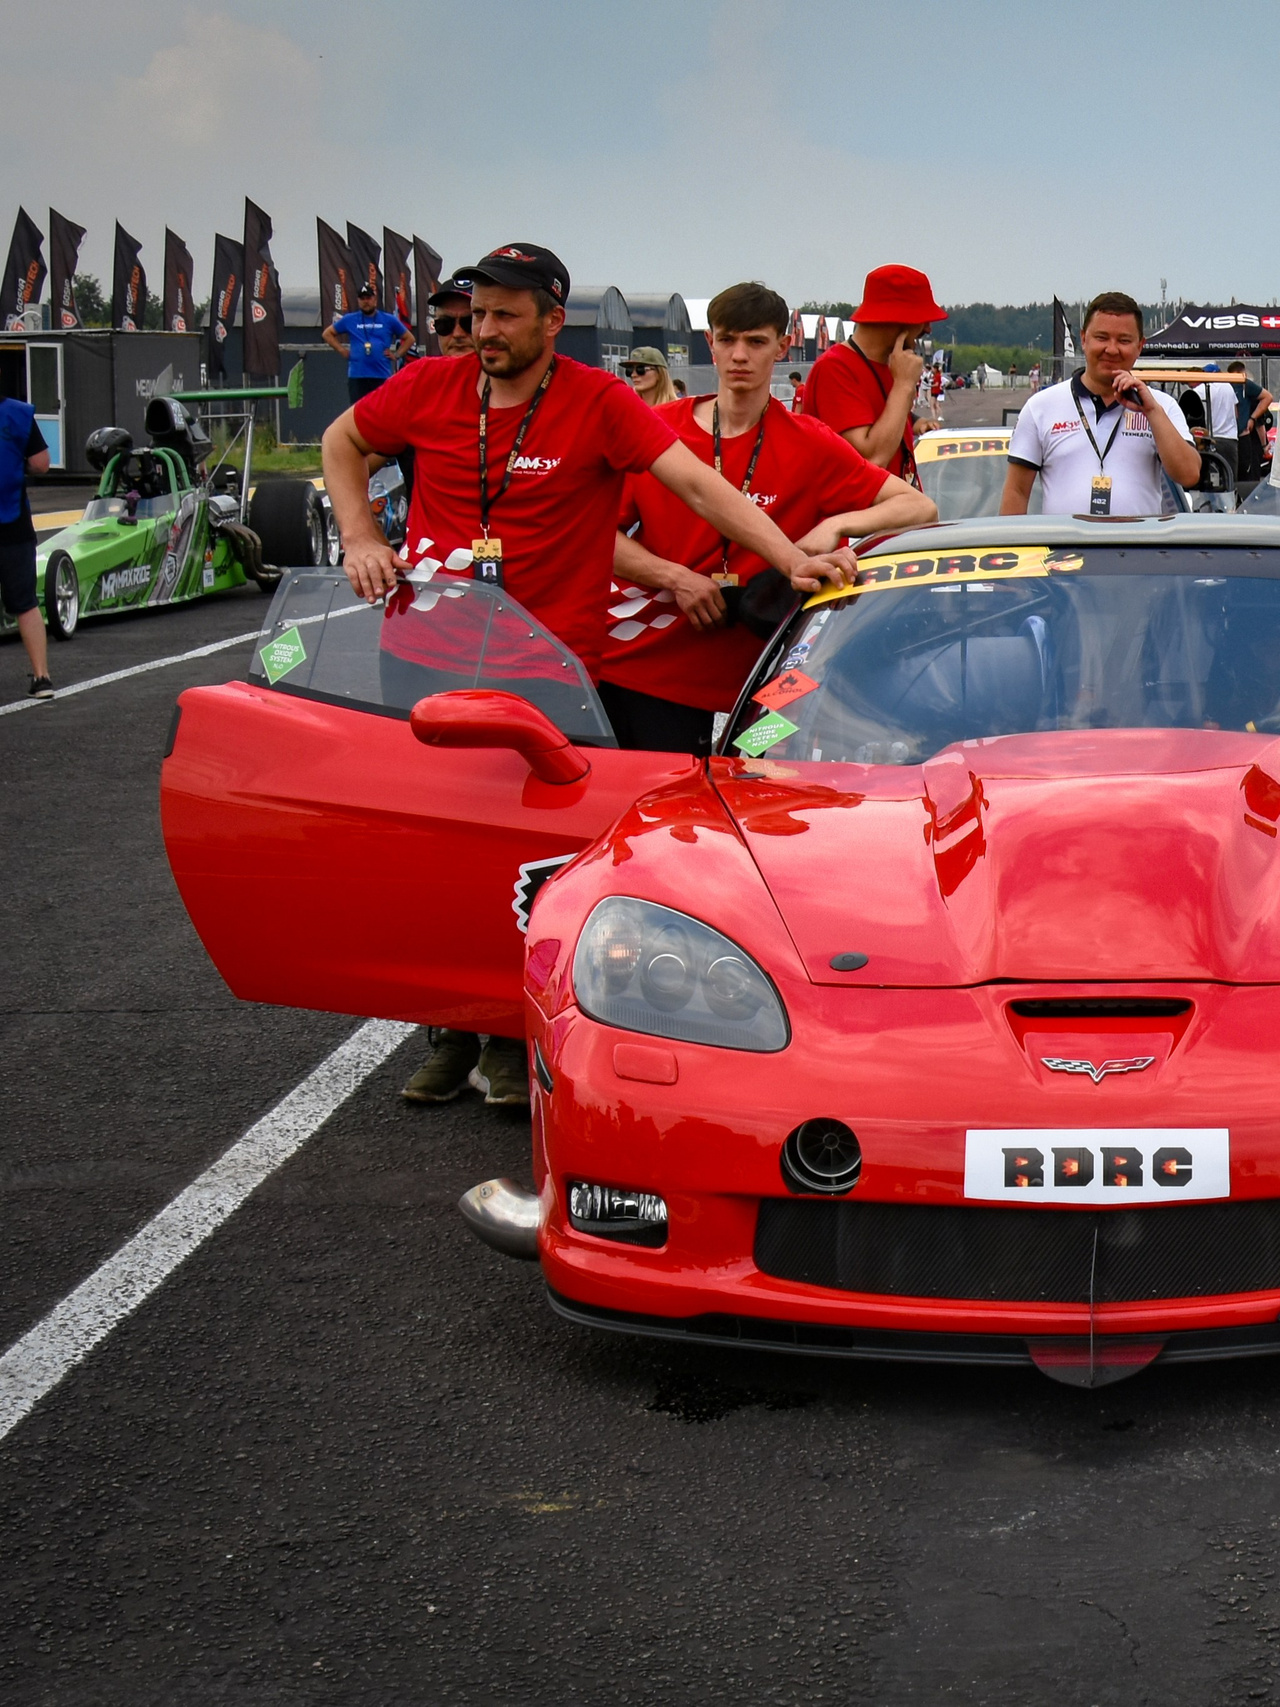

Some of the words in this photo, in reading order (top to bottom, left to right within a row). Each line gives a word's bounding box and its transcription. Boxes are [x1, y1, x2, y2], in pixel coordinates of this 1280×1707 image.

[1209, 342, 1260, 350] ПРОИЗВОДСТВО
[937, 440, 1011, 456] RDR
[852, 552, 1019, 588] RDRC
[761, 688, 803, 699] ALCOHOL
[749, 723, 784, 734] NITROUS
[752, 729, 776, 738] OXIDE
[746, 733, 779, 744] SYSTEM
[1001, 1147, 1193, 1187] RDRC
